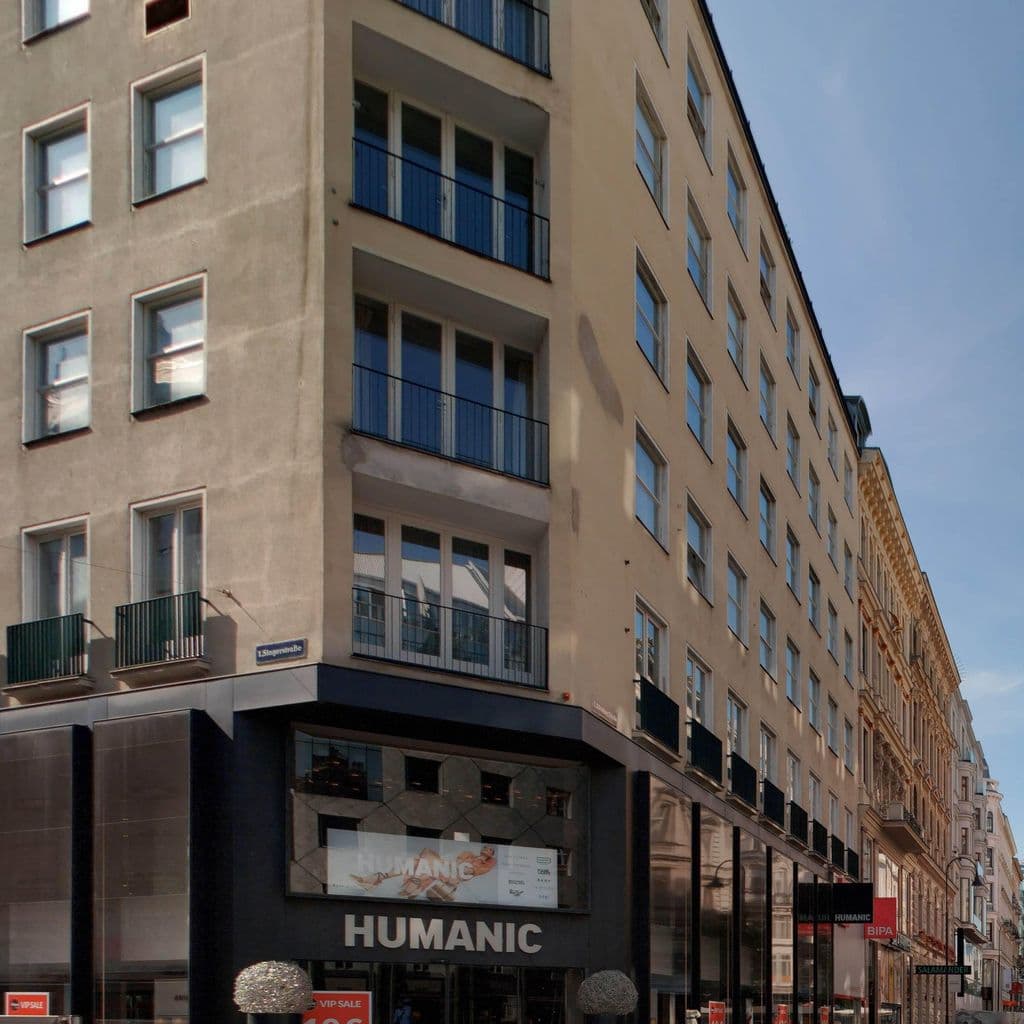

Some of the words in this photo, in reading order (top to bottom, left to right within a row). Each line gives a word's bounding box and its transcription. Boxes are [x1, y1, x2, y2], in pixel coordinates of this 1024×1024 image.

[834, 913, 871, 921] HUMANIC
[344, 913, 543, 954] HUMANIC
[867, 926, 894, 936] BIPA
[917, 966, 969, 974] SALAMANDER
[320, 1000, 336, 1008] VIP
[337, 1000, 362, 1008] SALE
